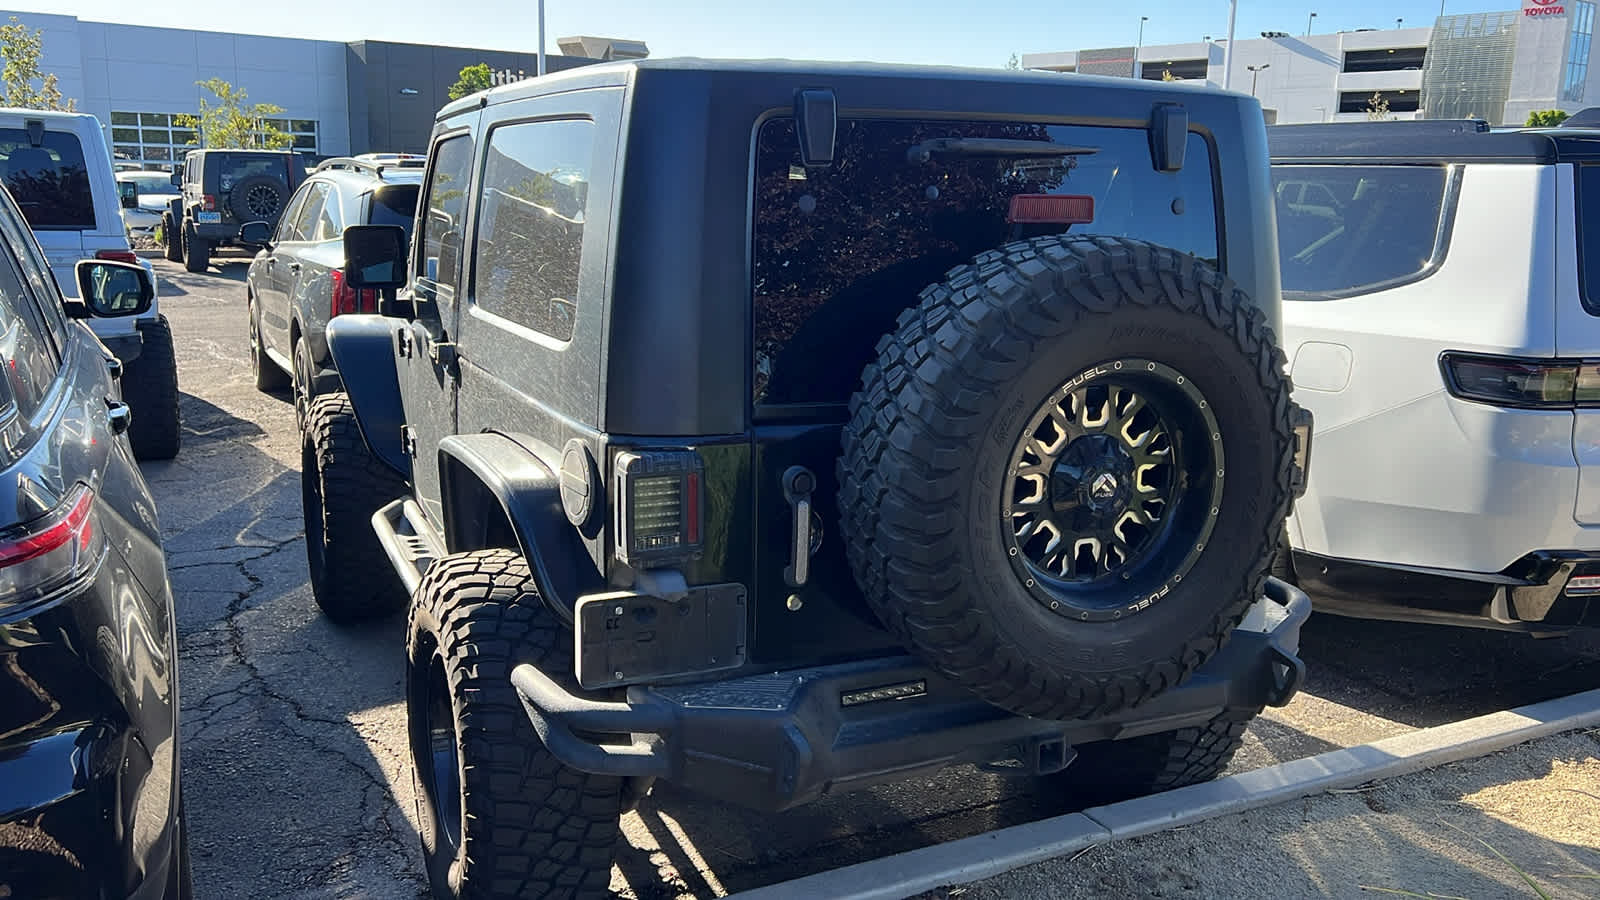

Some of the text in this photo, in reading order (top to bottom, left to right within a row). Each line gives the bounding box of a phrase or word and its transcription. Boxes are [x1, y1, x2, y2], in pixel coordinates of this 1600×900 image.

[1524, 6, 1565, 16] TOYOTA
[490, 68, 533, 86] ithi
[1063, 367, 1107, 393] FUEL
[1128, 585, 1169, 612] FUEL
